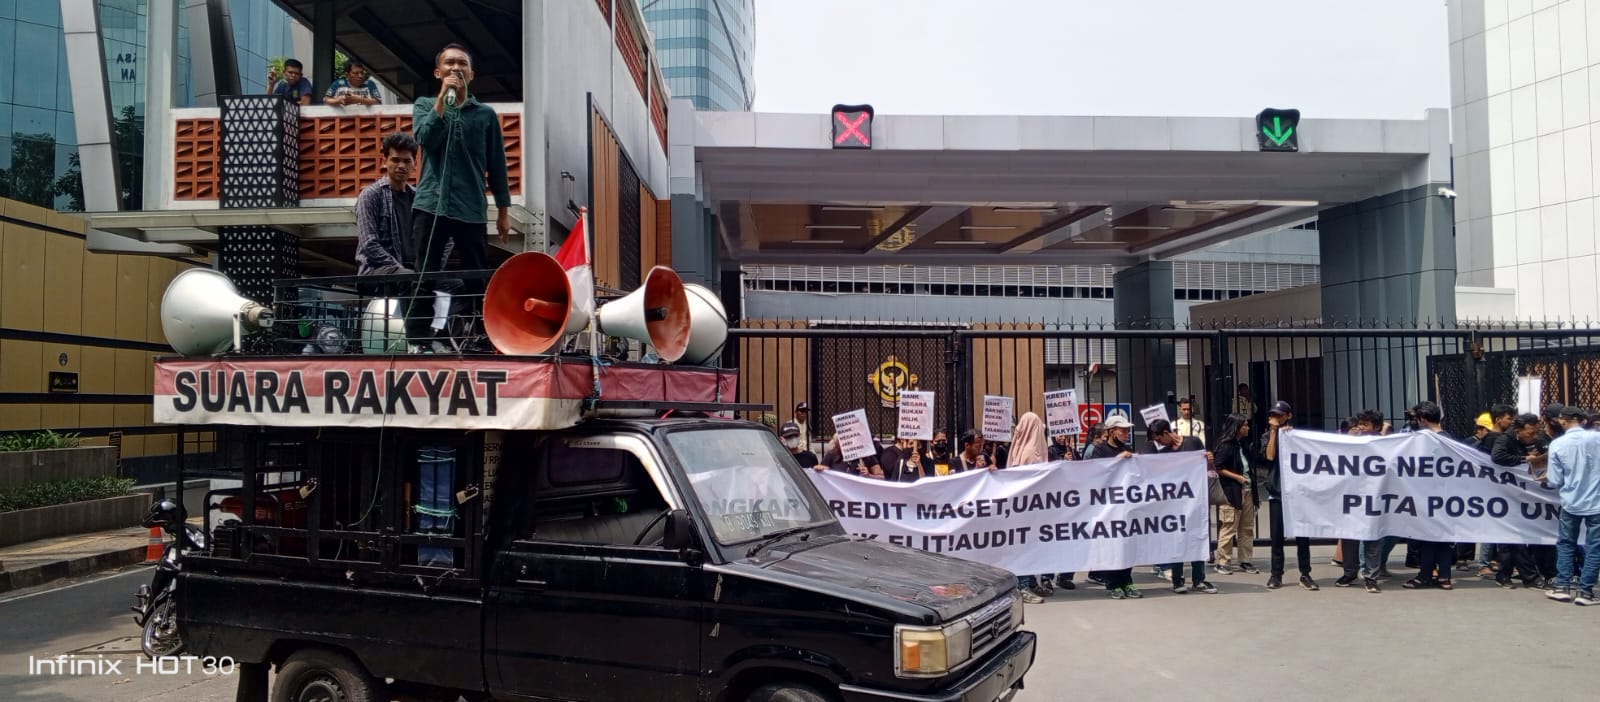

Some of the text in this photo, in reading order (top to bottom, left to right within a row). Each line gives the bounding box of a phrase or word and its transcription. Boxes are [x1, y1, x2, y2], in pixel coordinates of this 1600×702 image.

[173, 369, 508, 417] SUARA RAKYAT
[1045, 391, 1072, 400] KREDIT
[1046, 400, 1072, 409] MACET
[1049, 418, 1074, 426] BEBAN
[1050, 426, 1080, 435] RAKYAT
[1289, 453, 1527, 491] UANG NEGARA,
[829, 499, 907, 521] REDIT
[1090, 481, 1195, 505] NEGARA
[1342, 493, 1561, 521] PLTA POSO UN
[1039, 514, 1187, 543] SEKARANG!
